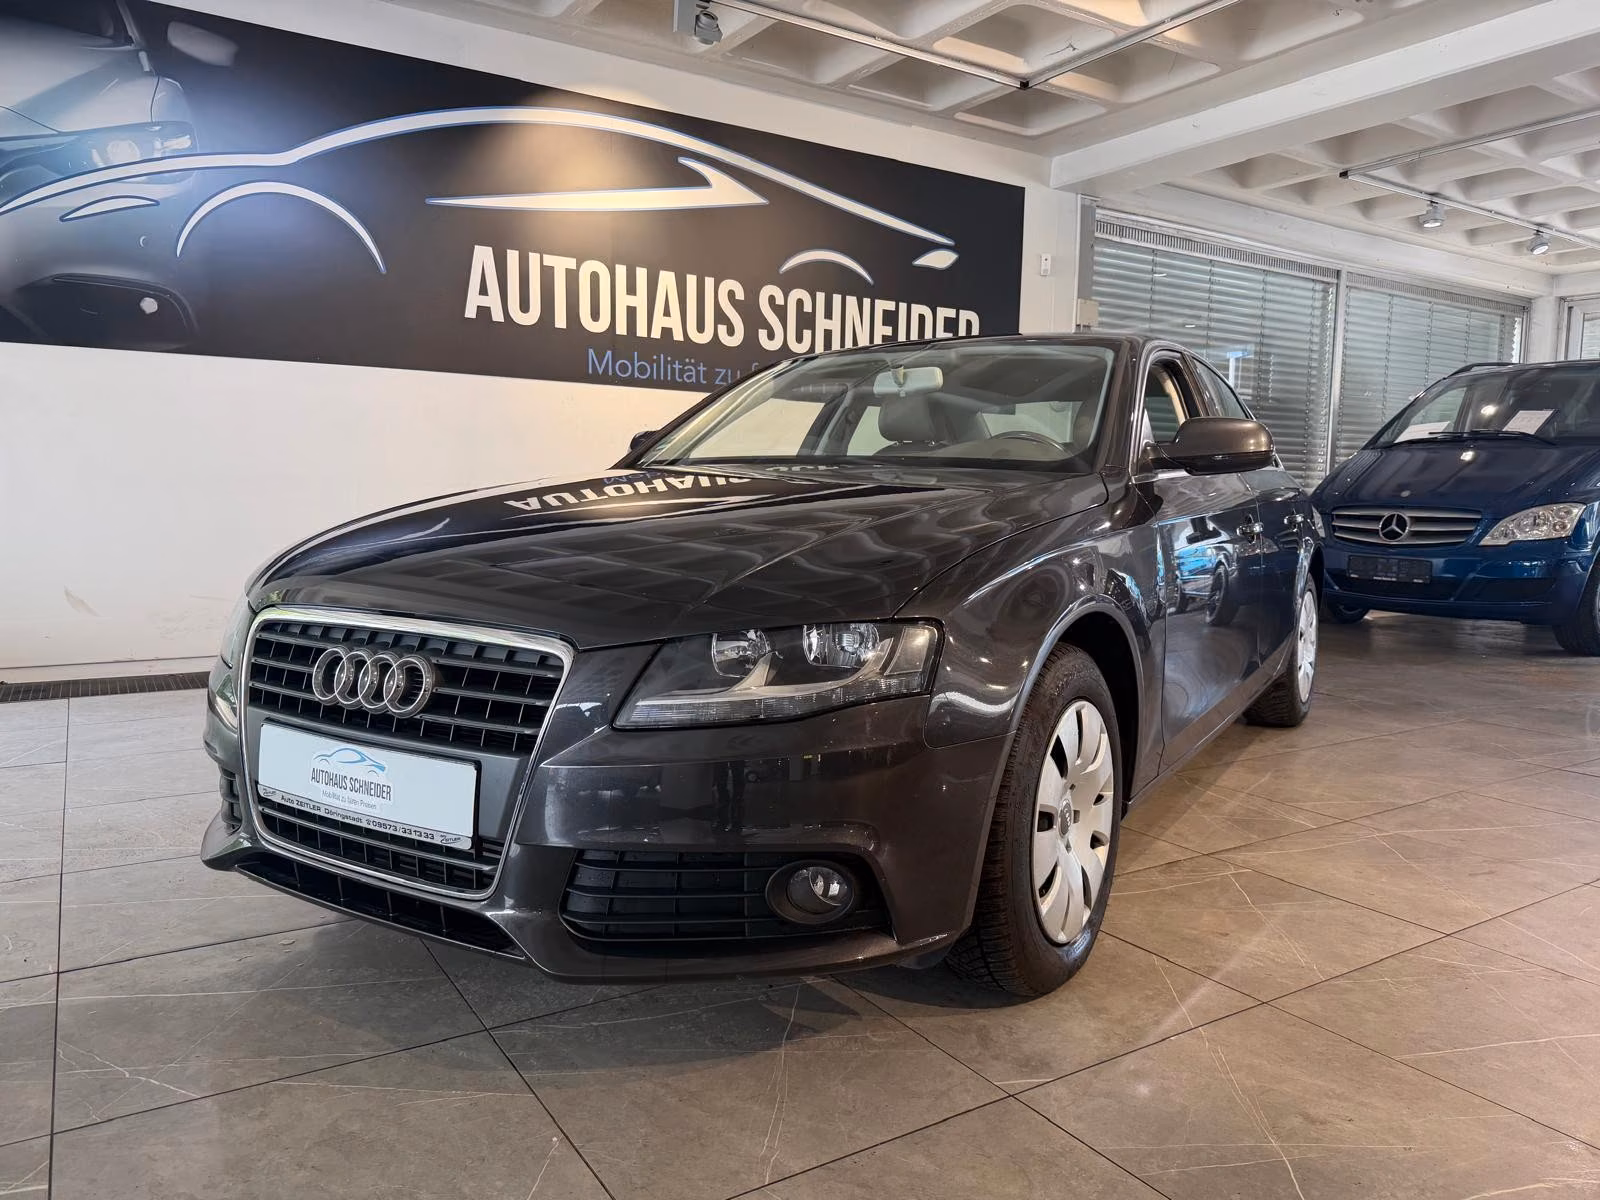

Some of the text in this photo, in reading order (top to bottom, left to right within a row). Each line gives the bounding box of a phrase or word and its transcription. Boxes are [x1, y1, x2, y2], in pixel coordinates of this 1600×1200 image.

[464, 245, 744, 347] AUTOHAUS
[587, 348, 708, 384] Mobilität
[311, 768, 391, 801] AUTOHAUS SCHNEIDER
[281, 795, 294, 805] Auto
[296, 799, 321, 813] ZEITLER
[324, 808, 363, 823] Döringstadt
